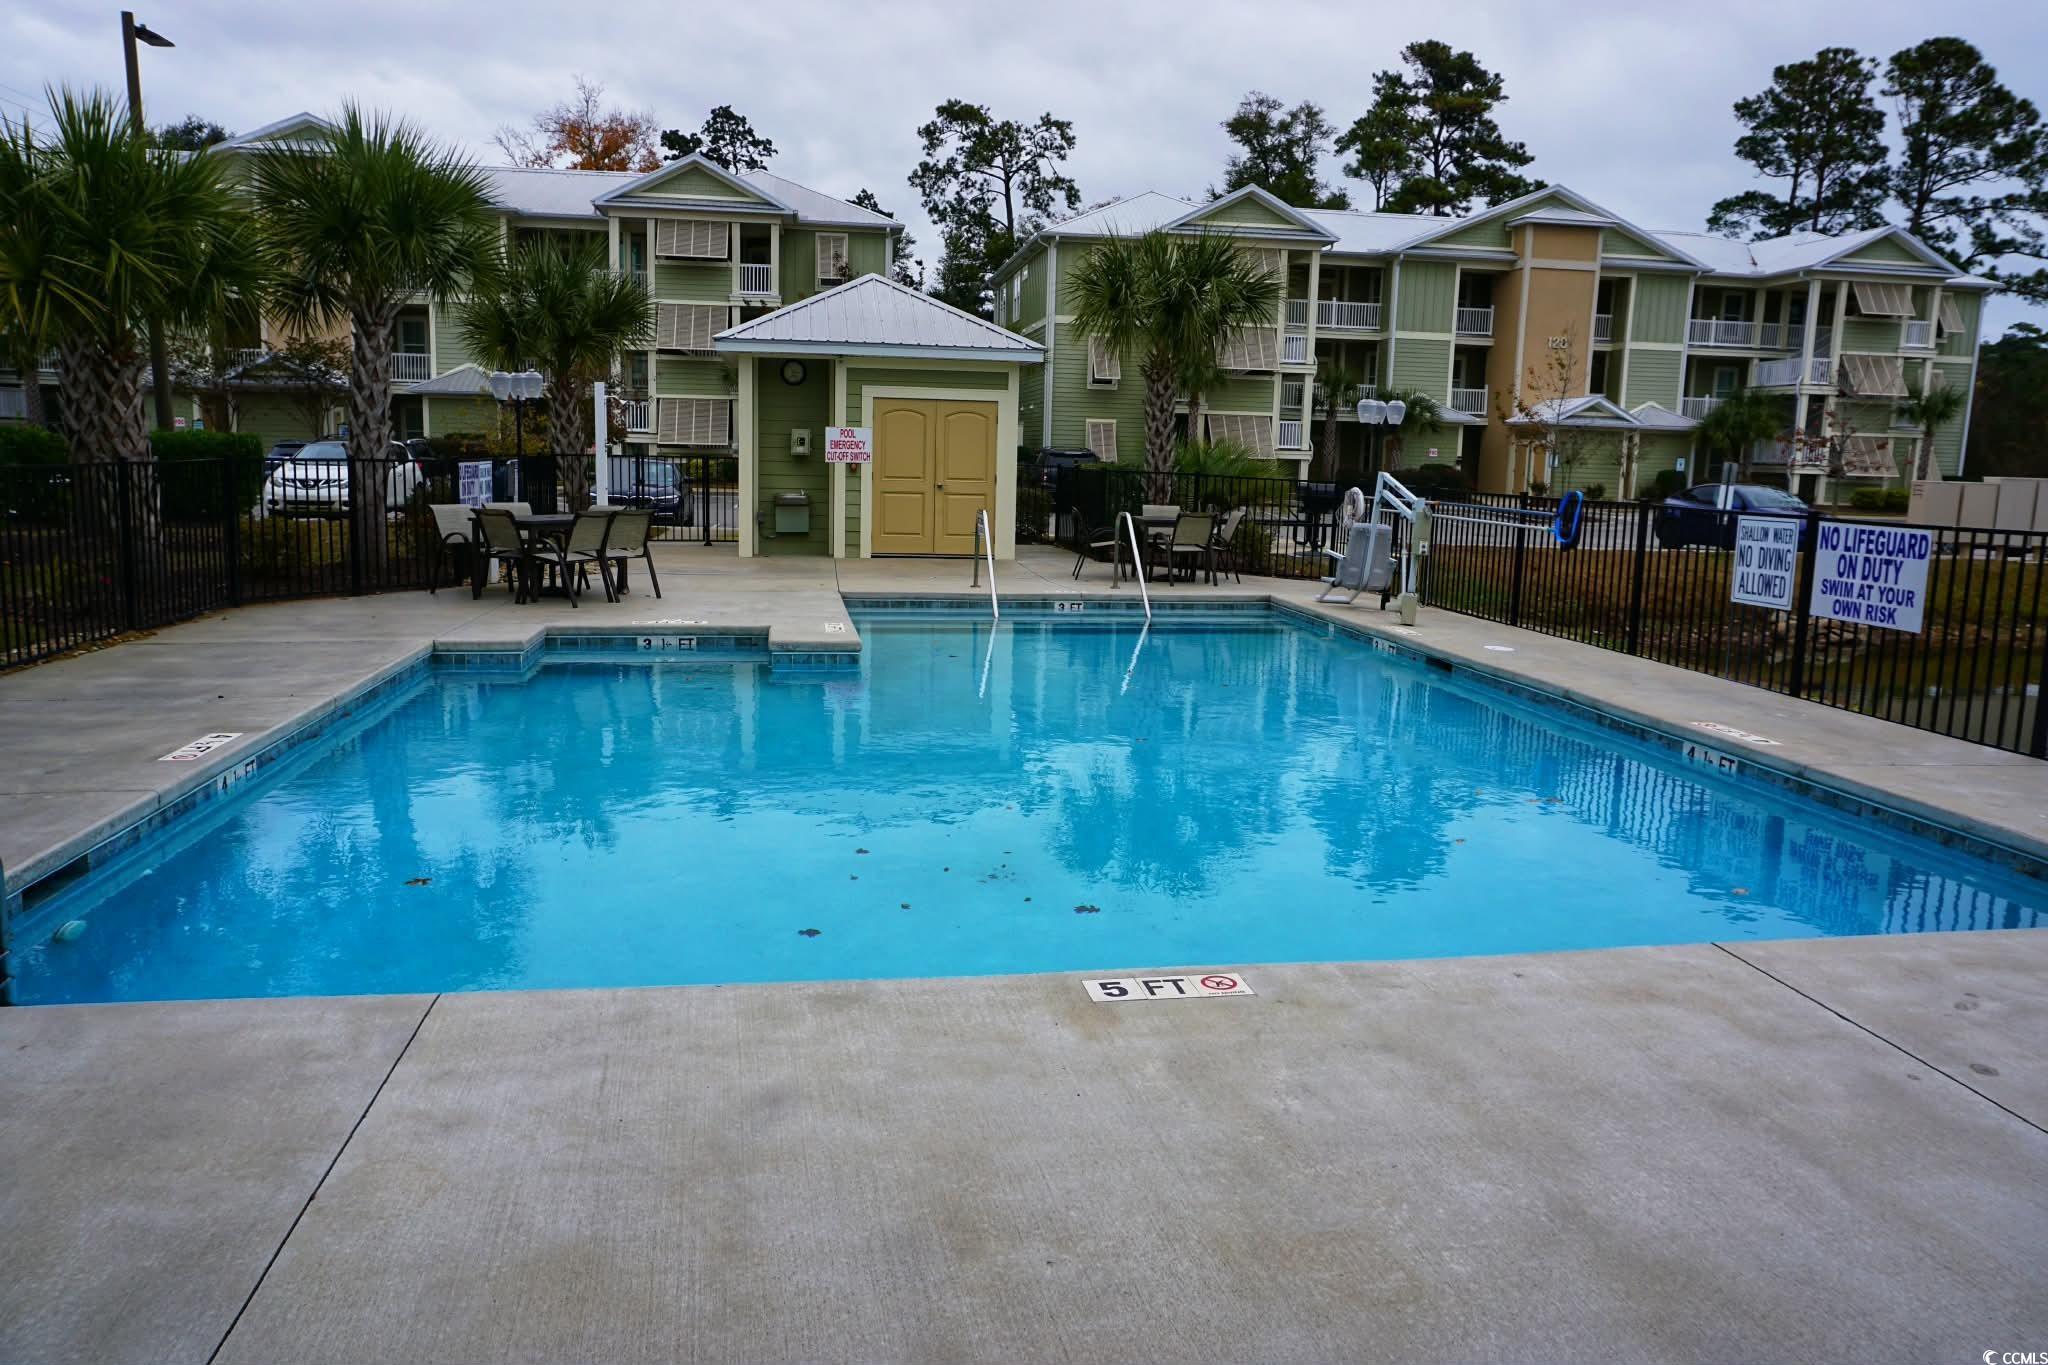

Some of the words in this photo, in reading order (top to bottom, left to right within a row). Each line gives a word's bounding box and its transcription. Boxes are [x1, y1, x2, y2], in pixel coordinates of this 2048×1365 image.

[840, 429, 856, 438] POOL
[830, 440, 866, 450] EMERGENCY
[850, 451, 871, 461] SWITCH
[1741, 525, 1769, 542] SHALLOW
[1773, 528, 1793, 544] WATER
[1820, 525, 1841, 551] NO
[1843, 527, 1929, 560] LIFEGUARD
[1739, 545, 1753, 568] NO
[1758, 547, 1792, 572] DIVING
[1837, 553, 1858, 579] ON
[1861, 556, 1904, 585] DUTY
[1738, 572, 1786, 599] ALLOWED
[1821, 578, 1855, 598] SWIM
[1857, 583, 1875, 600] AT
[1879, 586, 1915, 609] YOUR
[1833, 598, 1862, 619] OWN
[1865, 603, 1898, 625] RISK
[643, 638, 652, 650] 3
[679, 638, 694, 650] FT
[1719, 755, 1735, 771] FT
[1098, 981, 1129, 998] 5
[1141, 978, 1187, 996] FT
